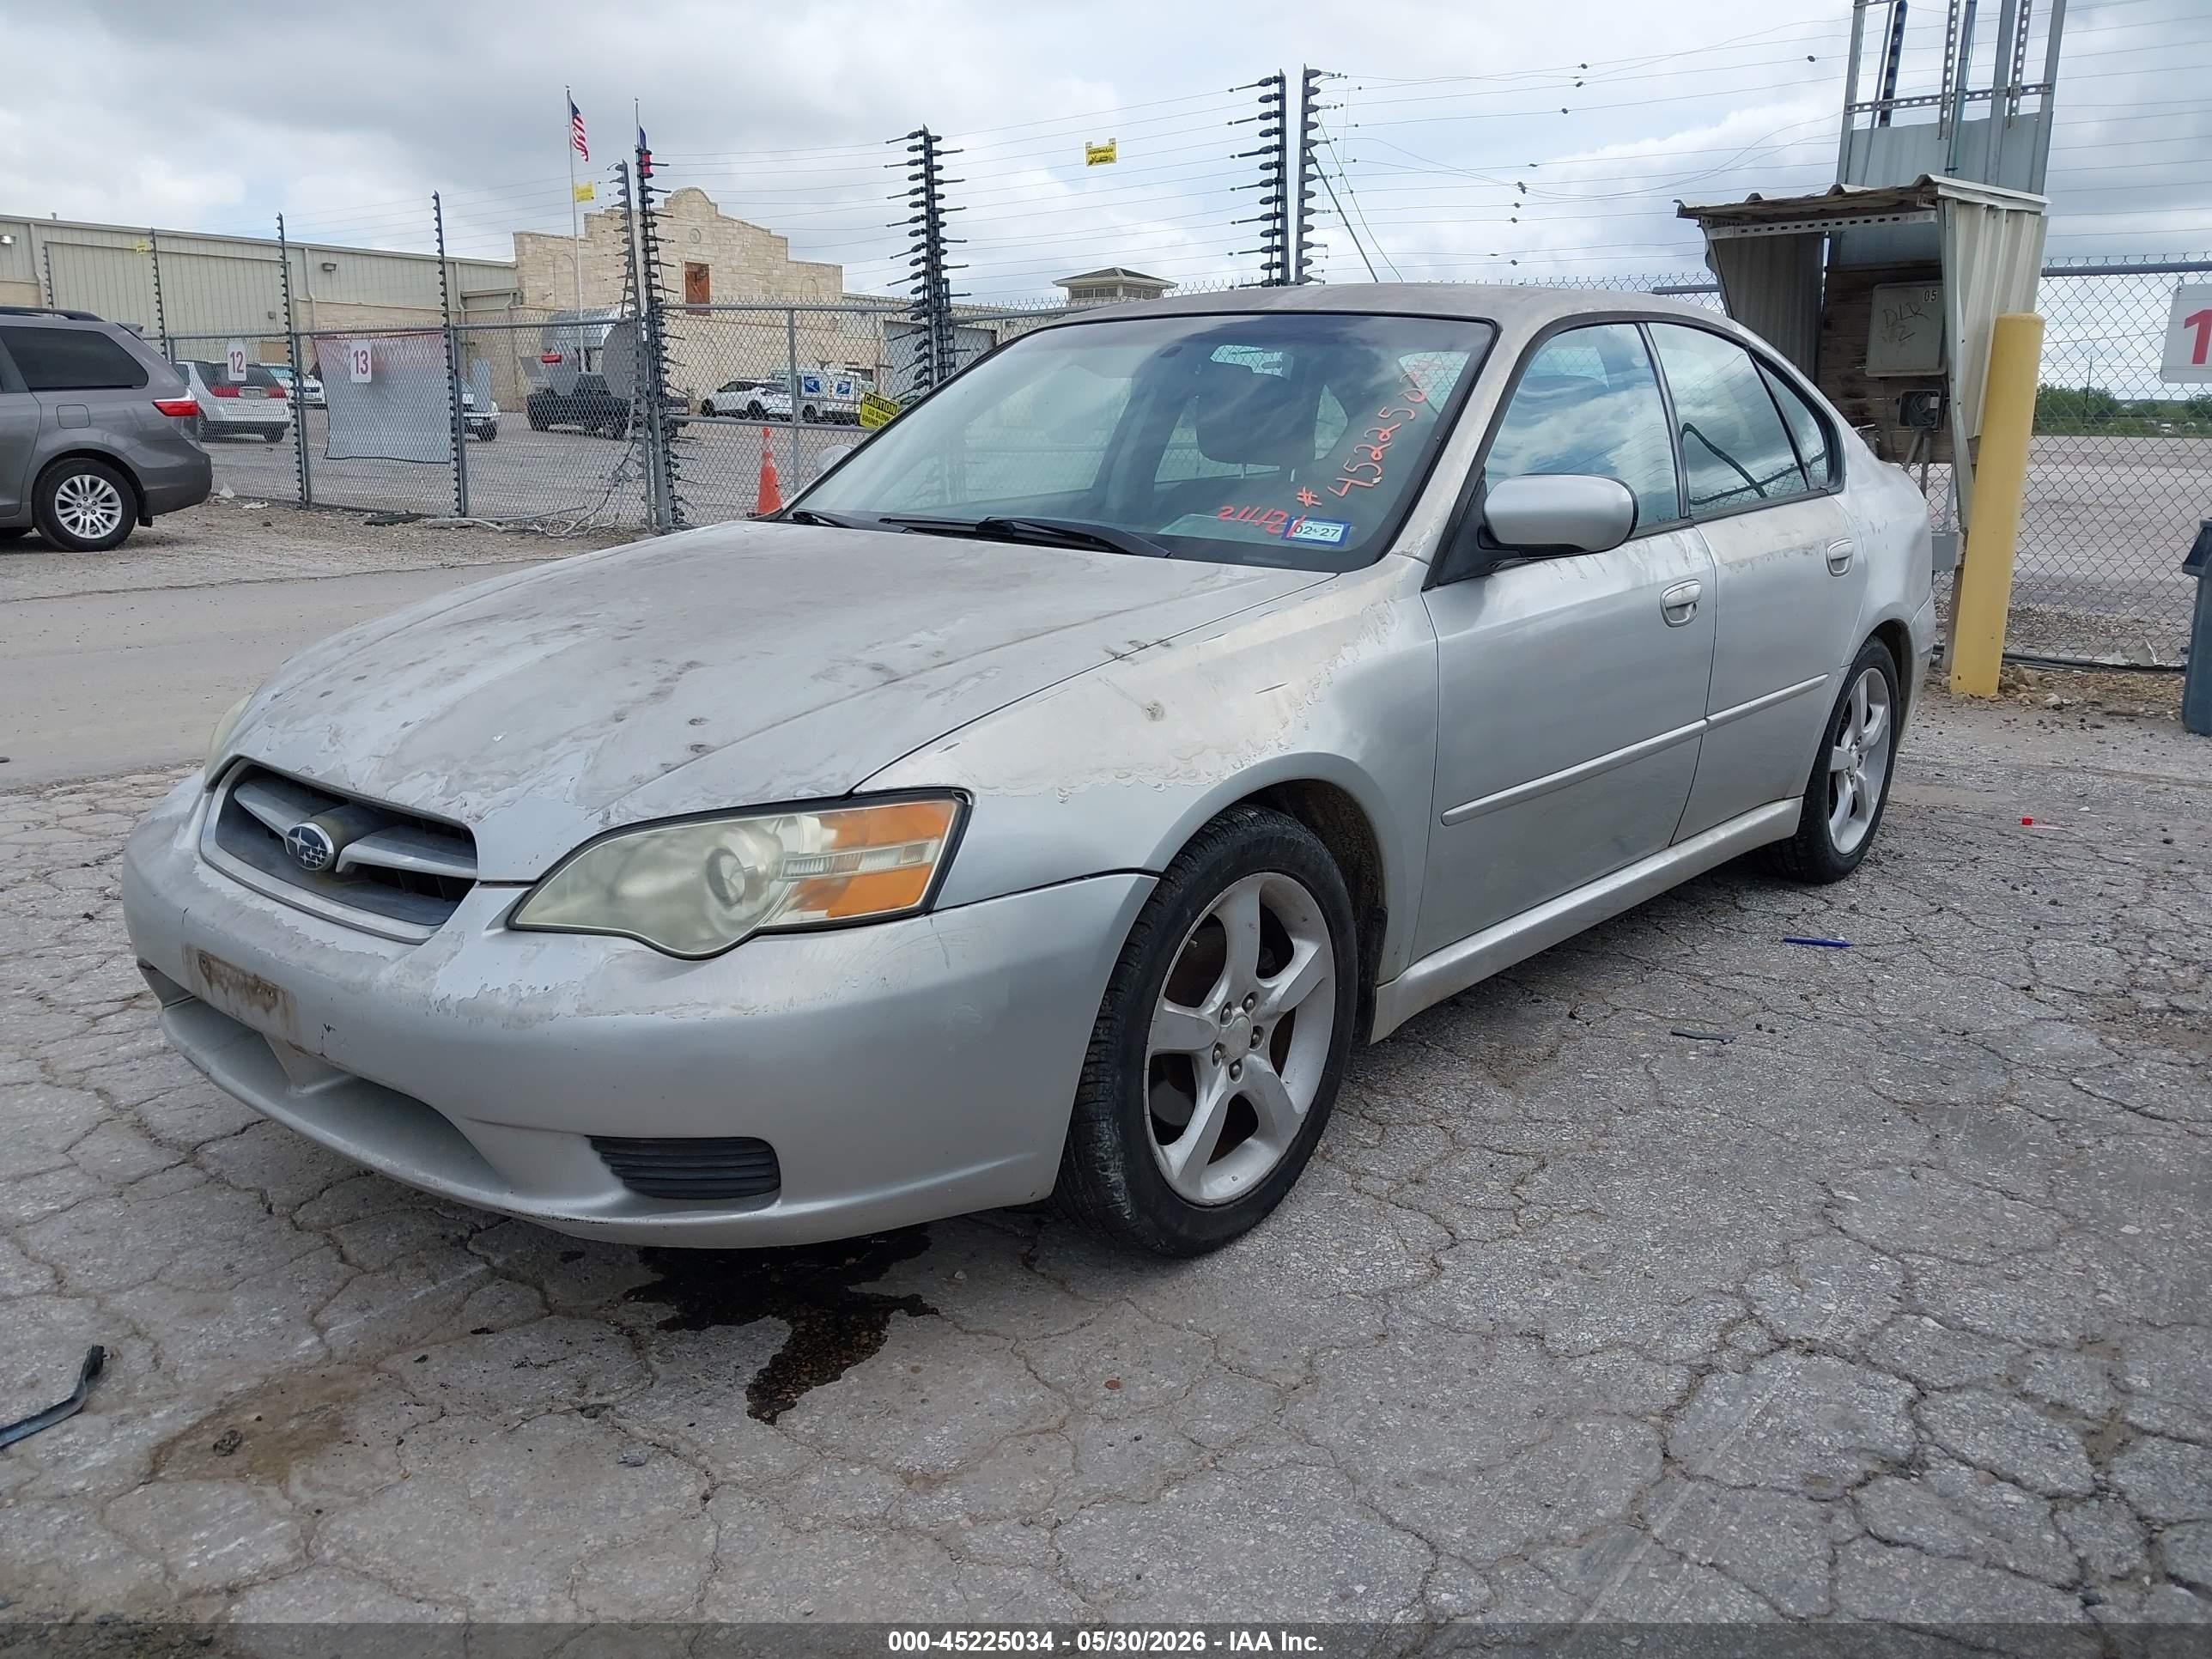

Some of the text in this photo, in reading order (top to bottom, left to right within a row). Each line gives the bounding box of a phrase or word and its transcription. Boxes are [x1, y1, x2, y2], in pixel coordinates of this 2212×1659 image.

[1923, 289, 1938, 301] 05
[2184, 308, 2212, 365] 1
[229, 350, 244, 374] 12
[353, 349, 369, 374] 13
[865, 393, 896, 416] CAUTION
[1297, 486, 1322, 507] #
[1319, 527, 1340, 538] 27
